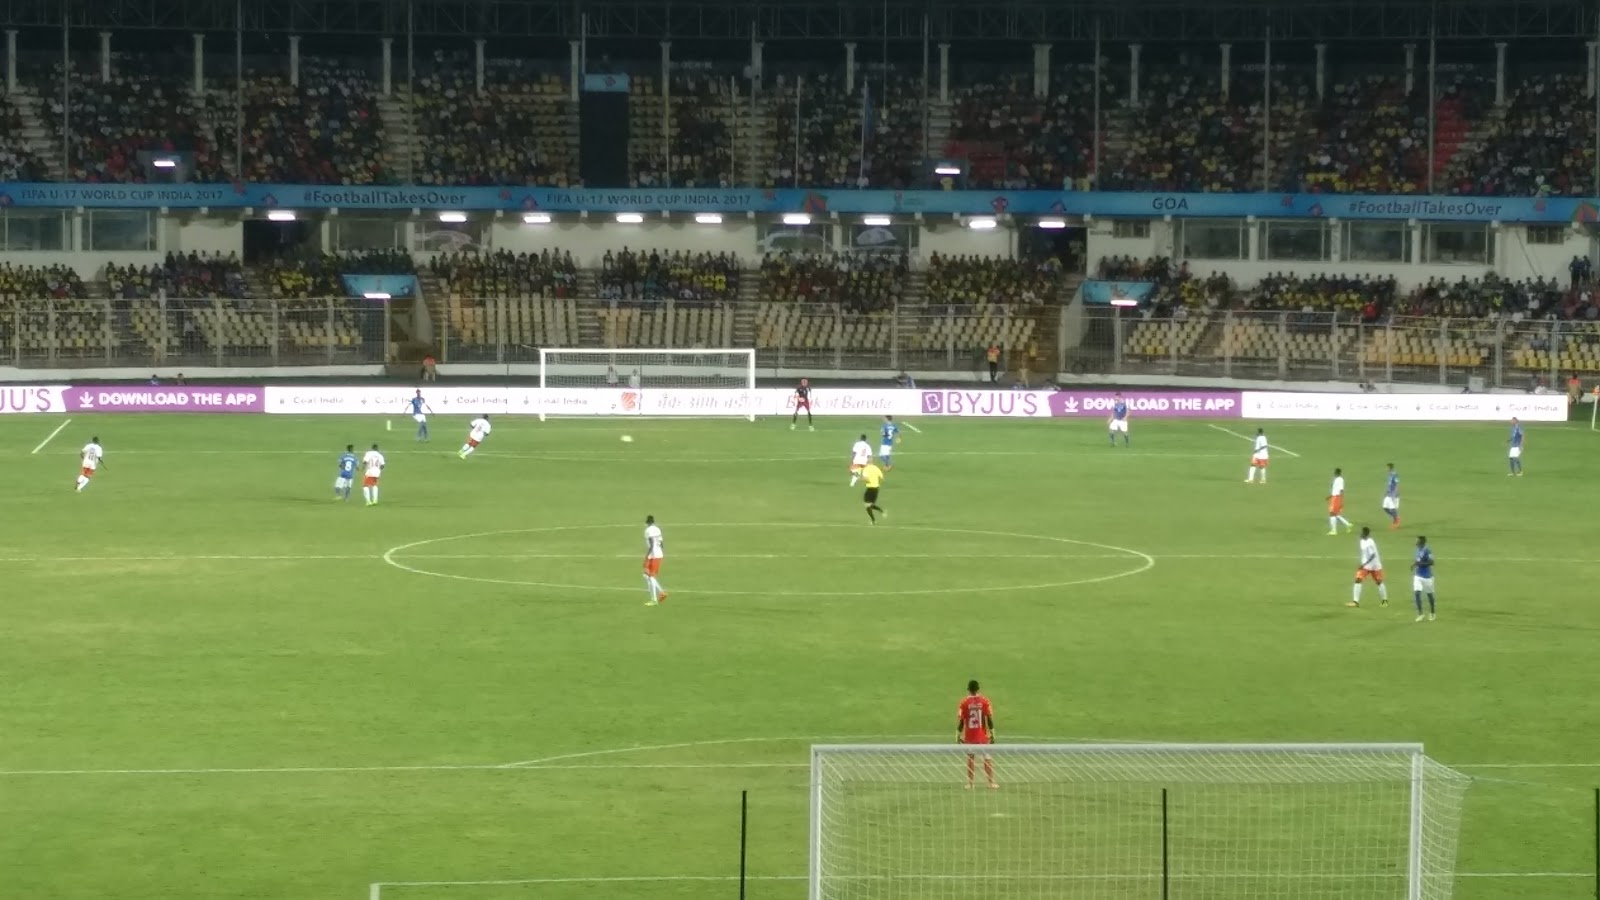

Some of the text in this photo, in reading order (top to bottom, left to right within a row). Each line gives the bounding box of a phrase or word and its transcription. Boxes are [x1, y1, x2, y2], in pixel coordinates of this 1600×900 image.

[21, 190, 223, 200] FIFA U-17 WORLD CUP INDIA 2017
[304, 190, 466, 205] #FootballTakesOver
[547, 194, 751, 205] FIFA U-17 WORLD CUP INDIA 2017
[1152, 197, 1189, 210] GOA
[1349, 200, 1502, 215] #FootballTakesOver
[98, 392, 257, 406] DOWNLOAD THE APP
[946, 391, 1038, 415] BYJU'S
[1172, 398, 1203, 411] THE
[1204, 398, 1235, 411] APP
[344, 460, 352, 472] 8
[968, 709, 982, 729] 21
